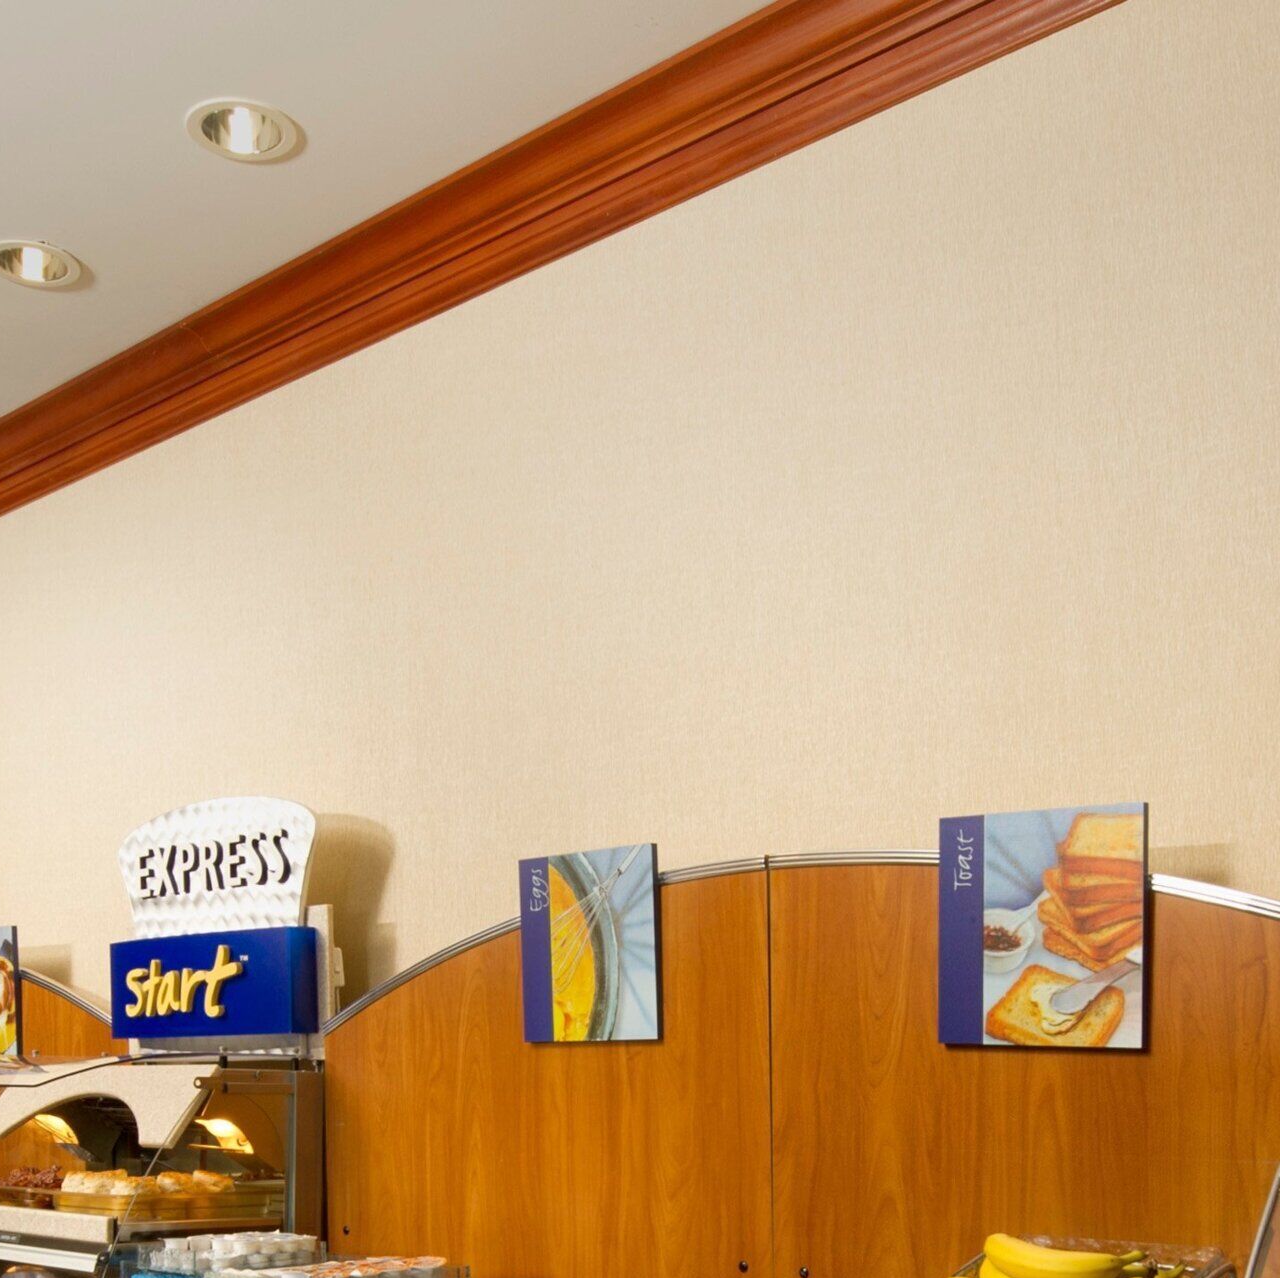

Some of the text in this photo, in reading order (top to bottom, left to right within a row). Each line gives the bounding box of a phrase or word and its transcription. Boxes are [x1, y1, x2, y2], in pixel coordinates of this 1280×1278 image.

[136, 828, 293, 900] EXPRESS
[529, 867, 550, 912] Eggs
[953, 829, 974, 892] Toast
[125, 943, 243, 1018] start
